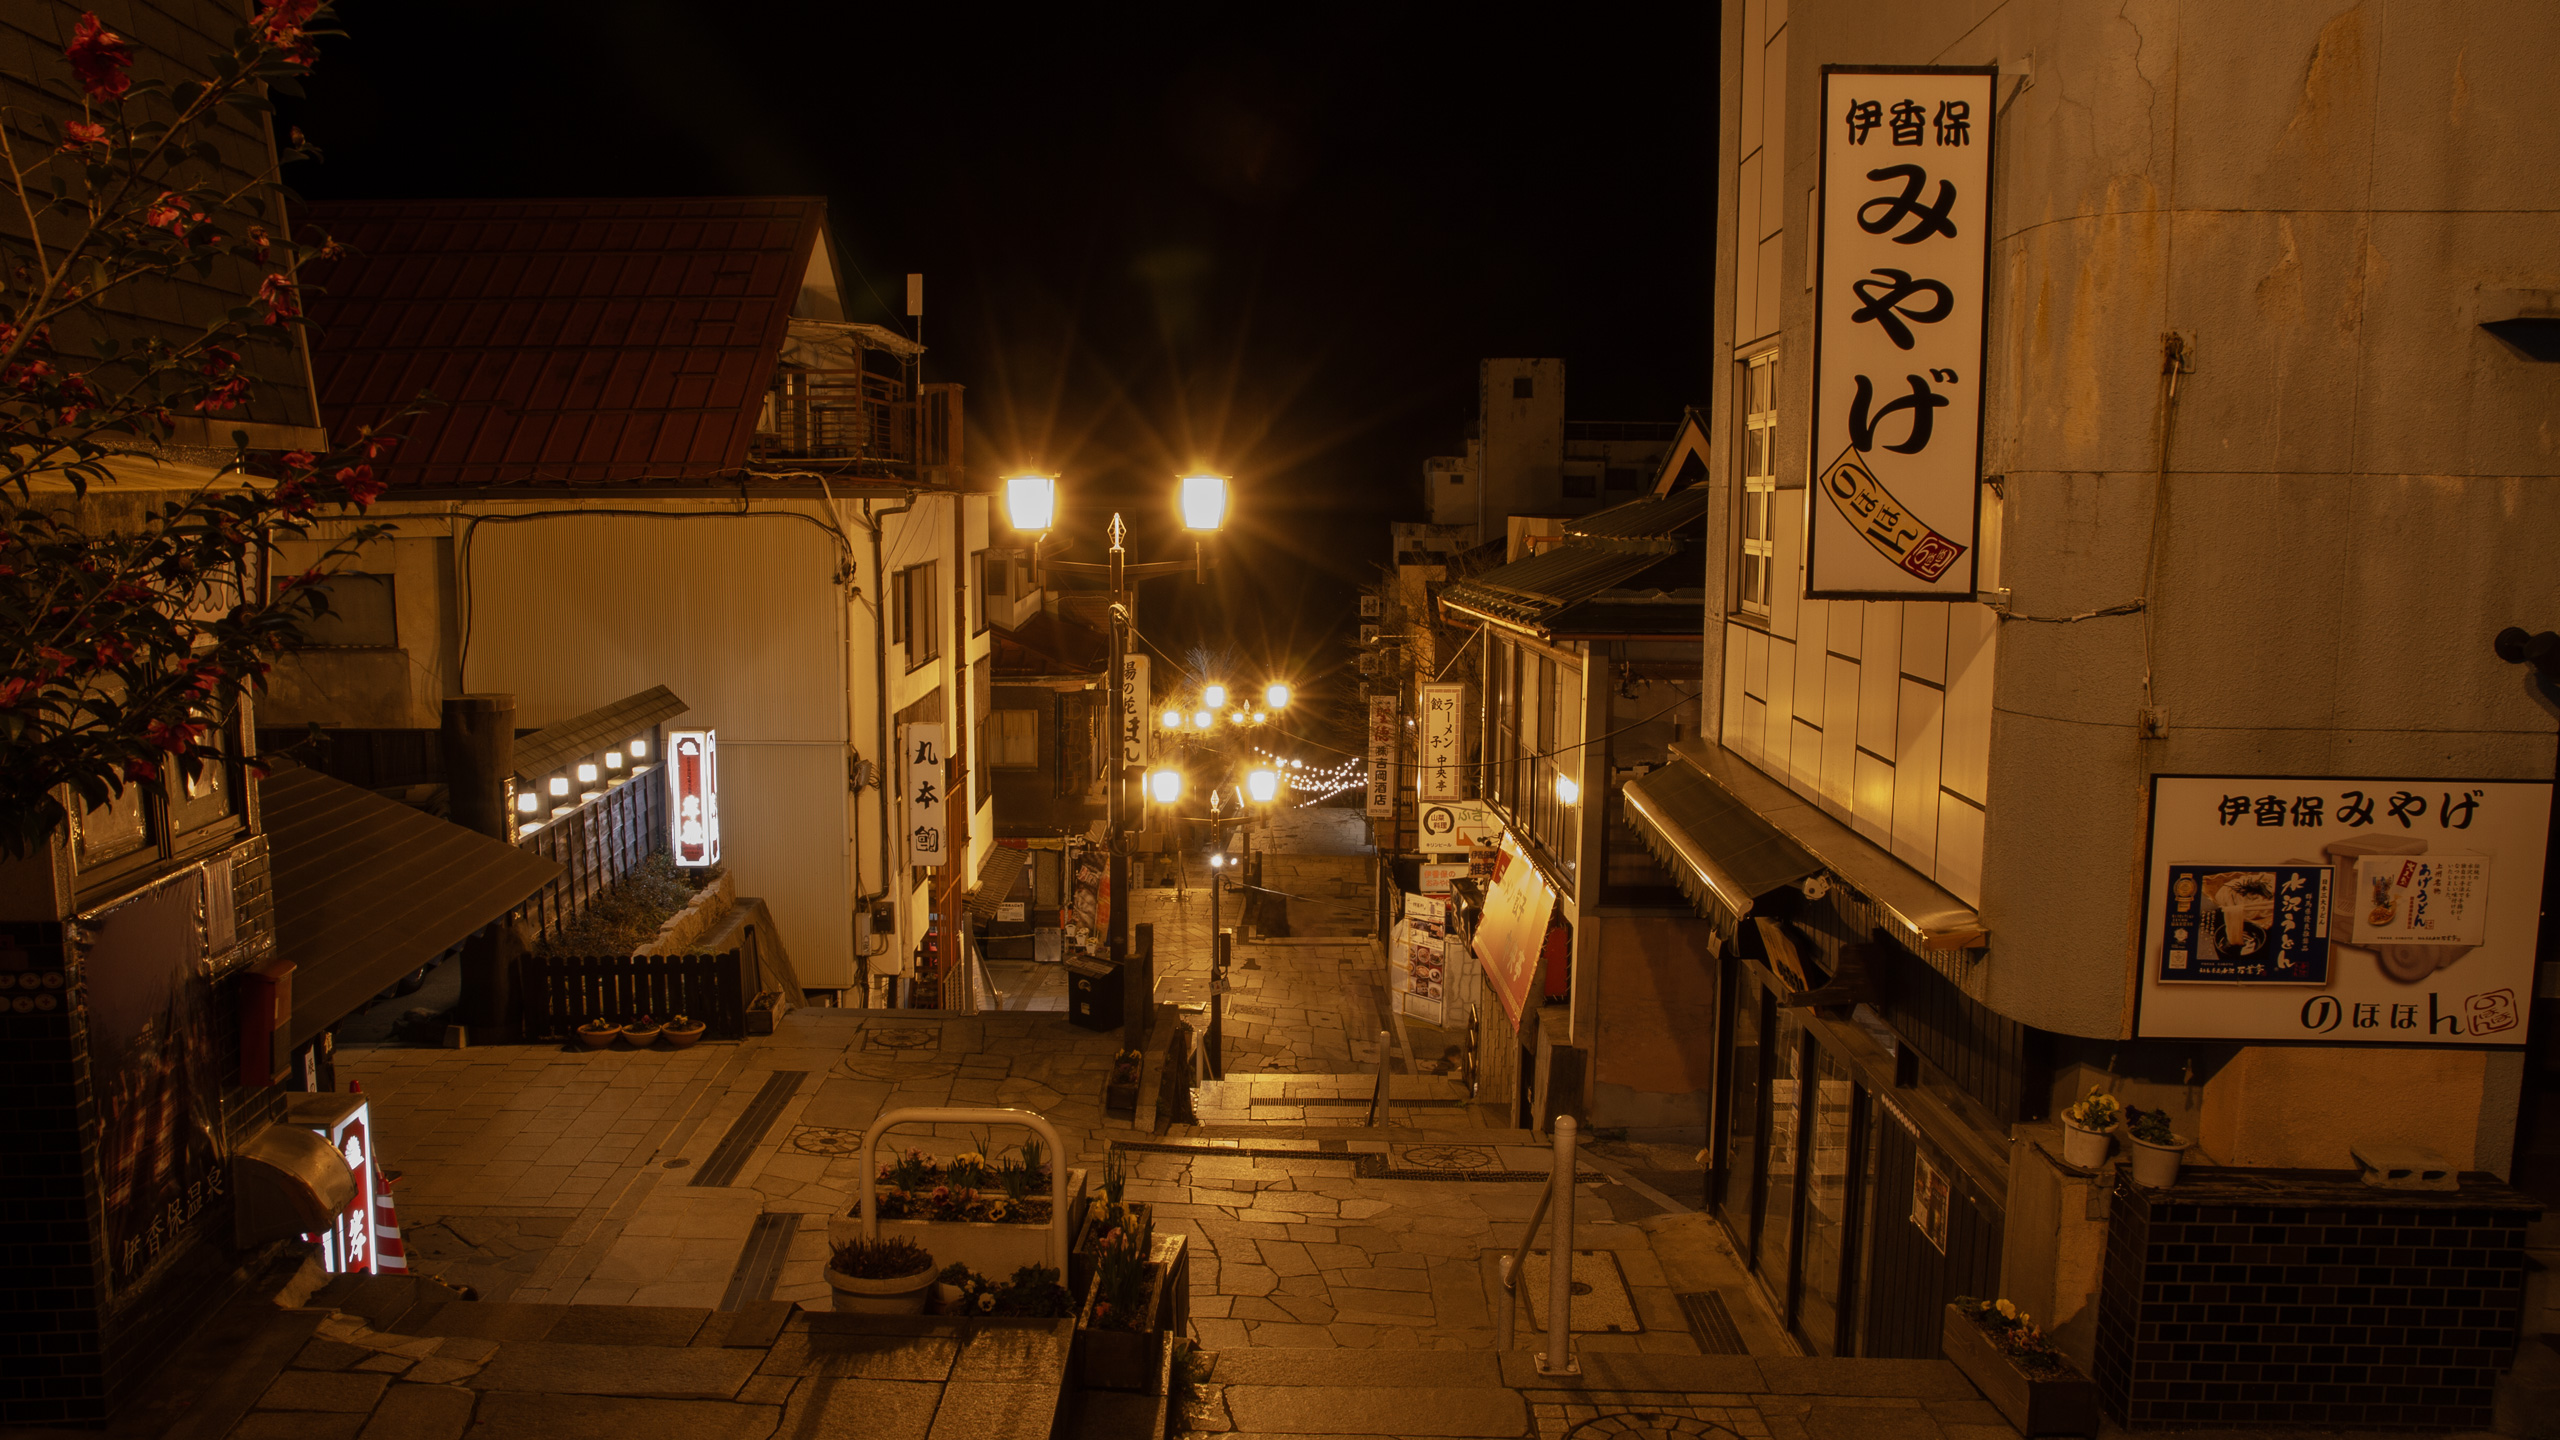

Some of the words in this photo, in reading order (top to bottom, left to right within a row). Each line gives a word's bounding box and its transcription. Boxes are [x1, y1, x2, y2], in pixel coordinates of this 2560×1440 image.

[1846, 99, 1971, 147] 伊香保
[1850, 162, 1960, 455] みやげ
[1830, 461, 1920, 557] のほほん
[1430, 697, 1443, 749] 餃子
[1443, 698, 1454, 749] ラーメン
[1435, 754, 1448, 792] 中央亭
[1423, 870, 1456, 879] 伊香保の
[2414, 864, 2433, 927] あげうどん
[2277, 872, 2308, 969] 水沢うどん
[2319, 878, 2328, 925] 日本三大うどん
[2300, 992, 2465, 1036] のほほん
[122, 1165, 225, 1276] 伊香保温泉
